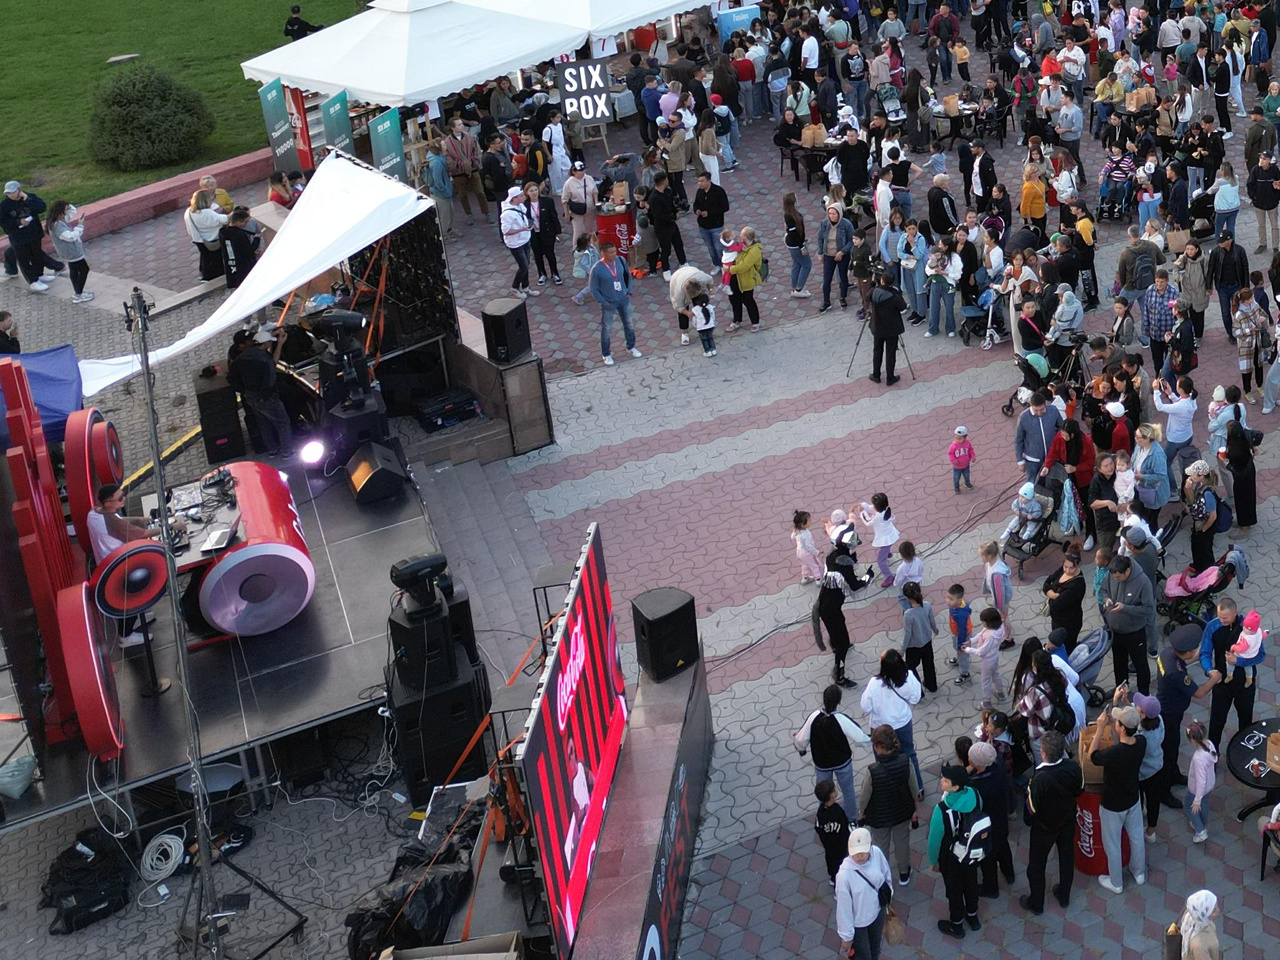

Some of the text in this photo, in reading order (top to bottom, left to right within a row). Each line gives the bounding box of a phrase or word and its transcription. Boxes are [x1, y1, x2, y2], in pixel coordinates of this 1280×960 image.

[564, 63, 604, 93] SIX
[564, 93, 610, 121] BOX
[615, 223, 629, 254] Coca-Cola
[557, 610, 586, 731] Coca-Cola
[1076, 804, 1095, 858] Coca-Cola
